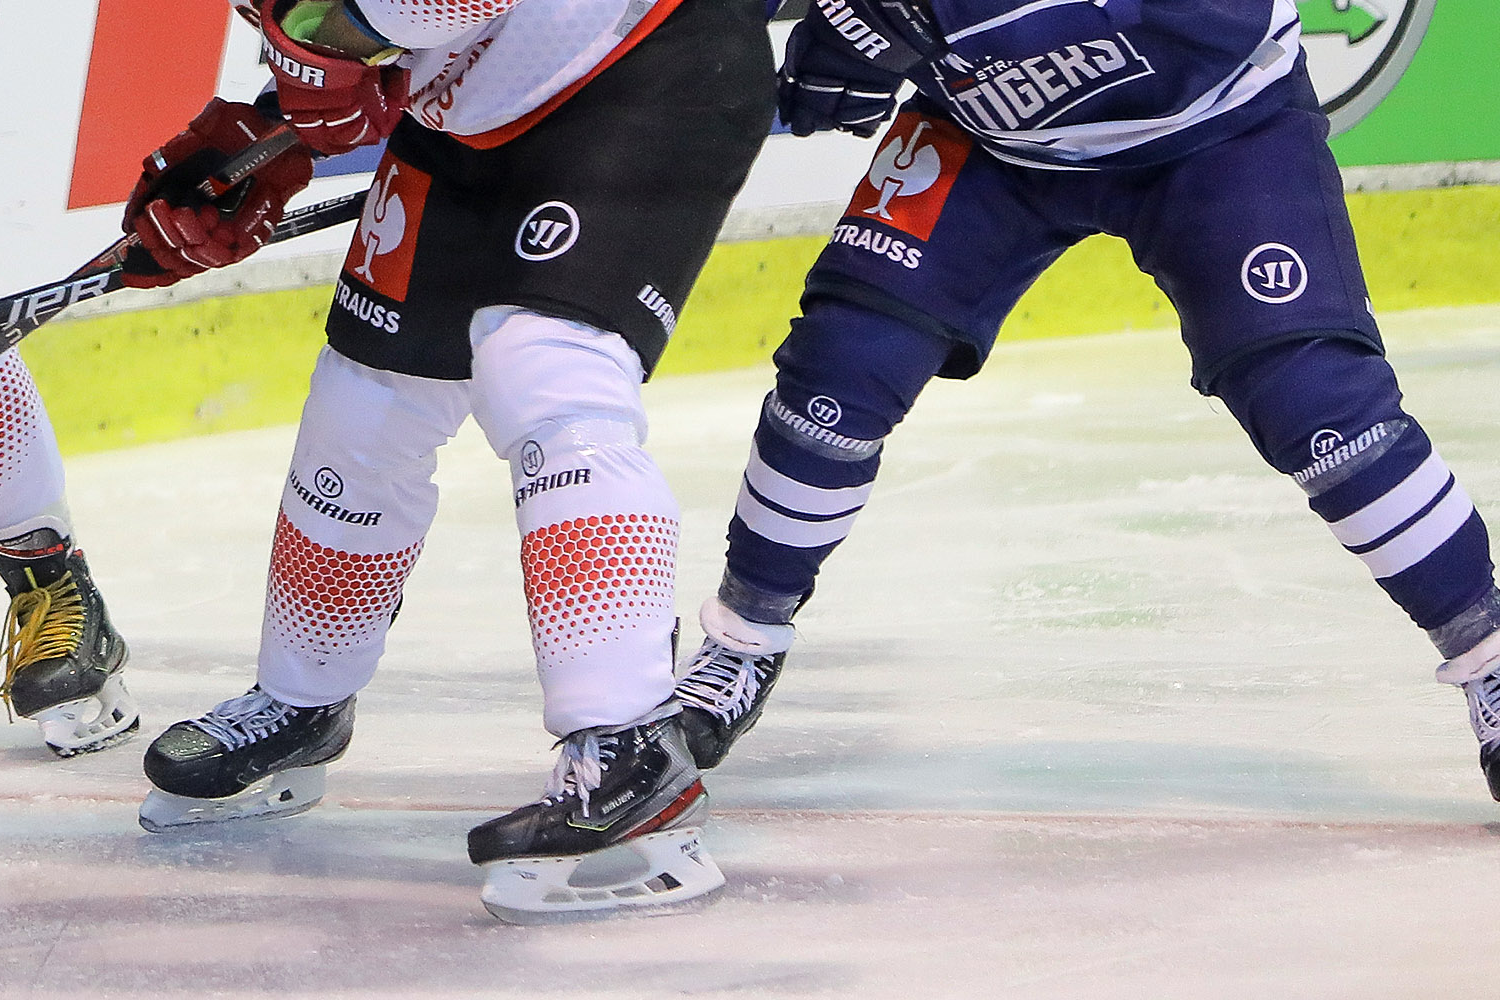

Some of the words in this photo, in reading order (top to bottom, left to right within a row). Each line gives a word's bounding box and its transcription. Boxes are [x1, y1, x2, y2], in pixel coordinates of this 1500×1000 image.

[770, 400, 874, 453] WARRIOR
[1293, 421, 1389, 485] WARRIOR
[289, 470, 383, 528] WARRIOR
[602, 789, 637, 816] BAUER
